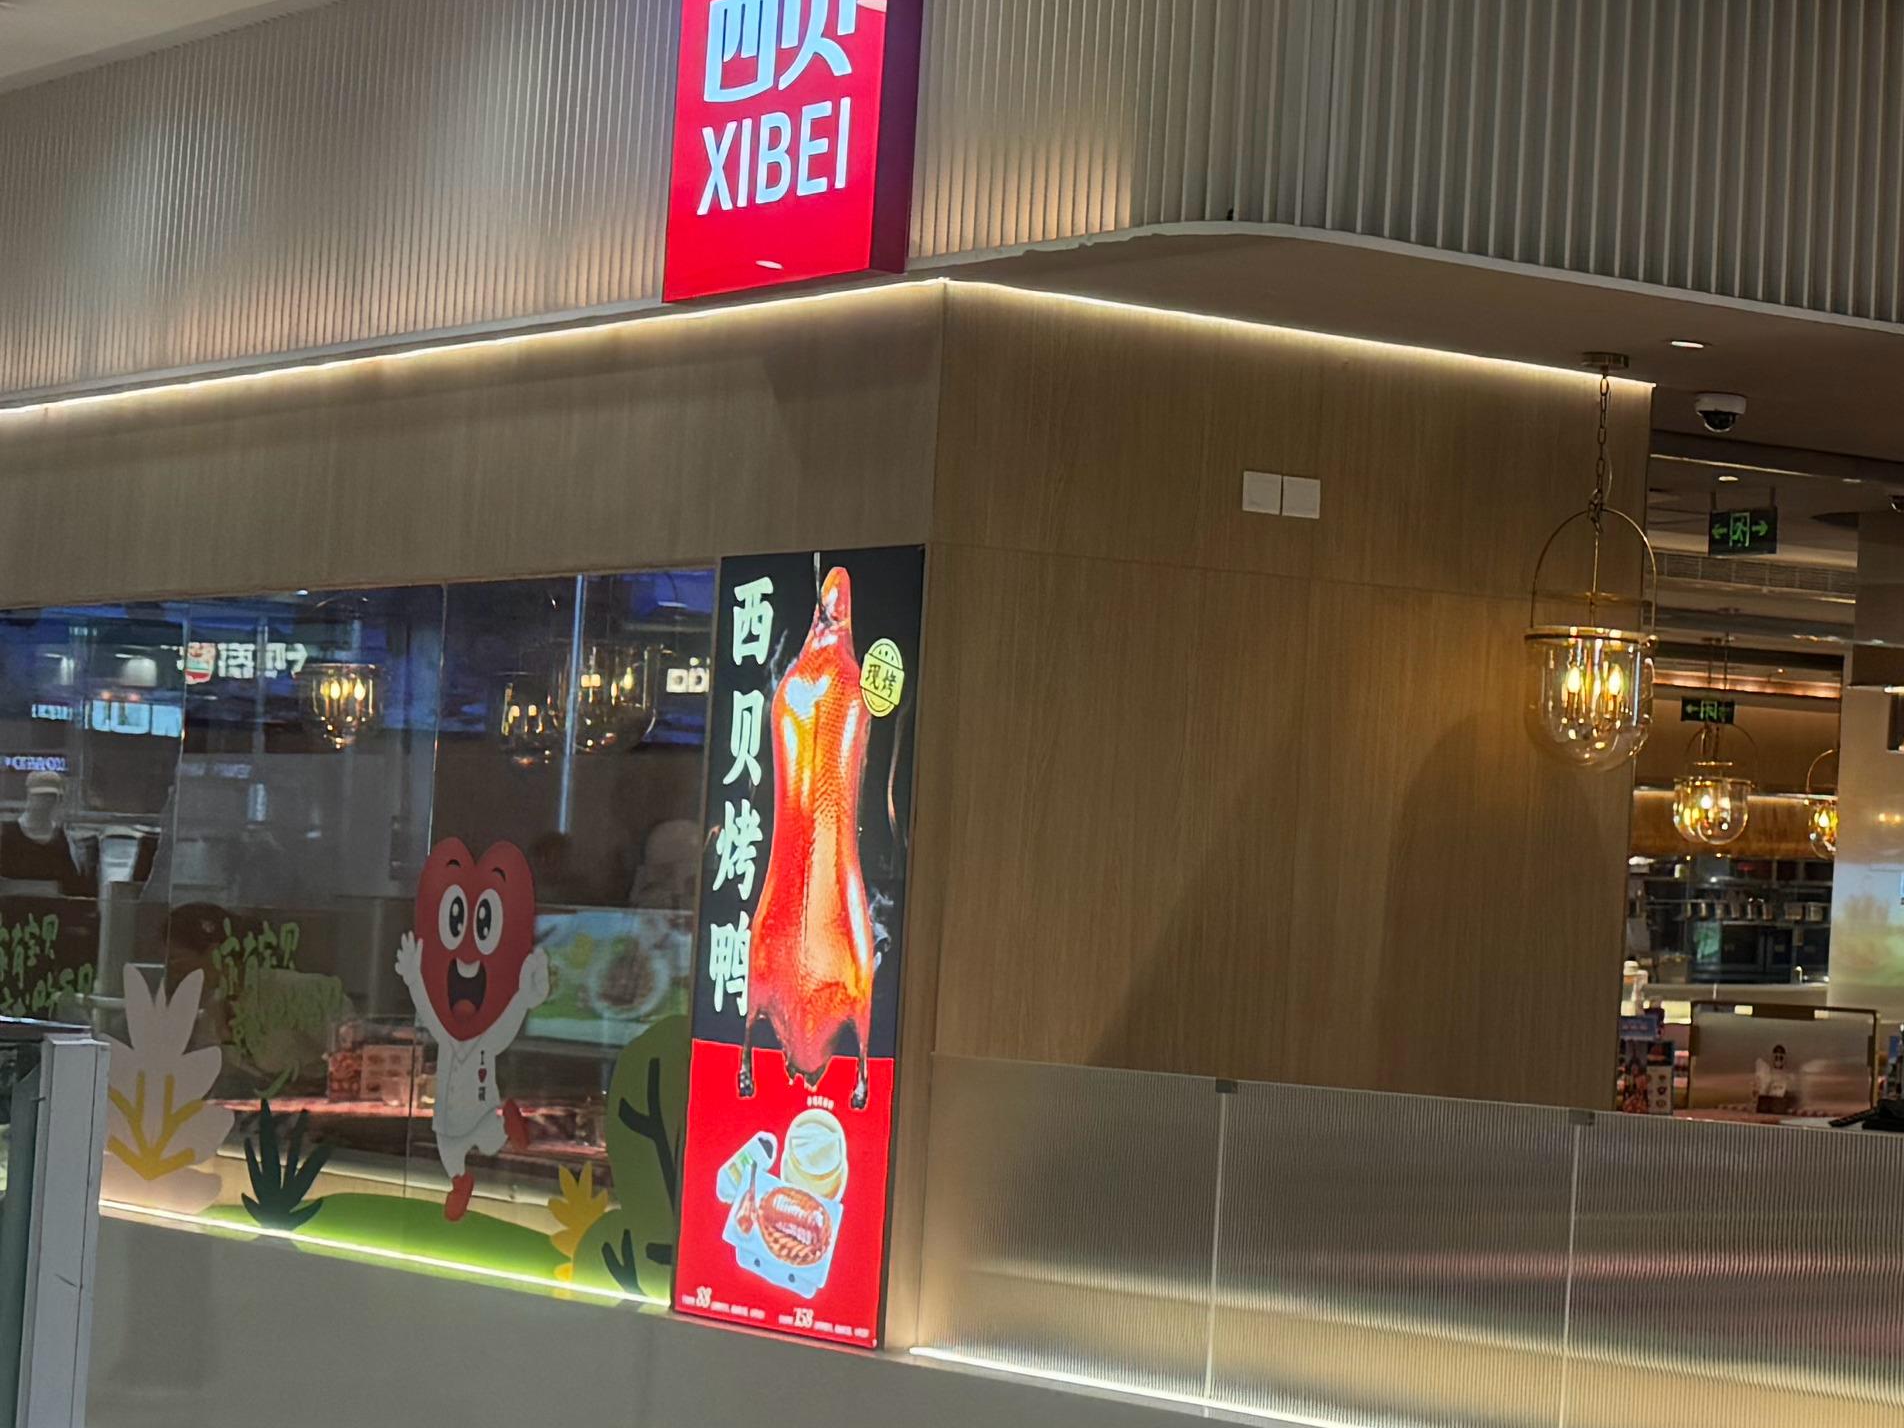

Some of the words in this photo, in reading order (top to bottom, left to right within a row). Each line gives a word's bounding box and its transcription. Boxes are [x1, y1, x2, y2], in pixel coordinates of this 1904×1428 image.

[696, 96, 851, 215] XIBEI
[709, 576, 774, 1017] 西贝烤鸭
